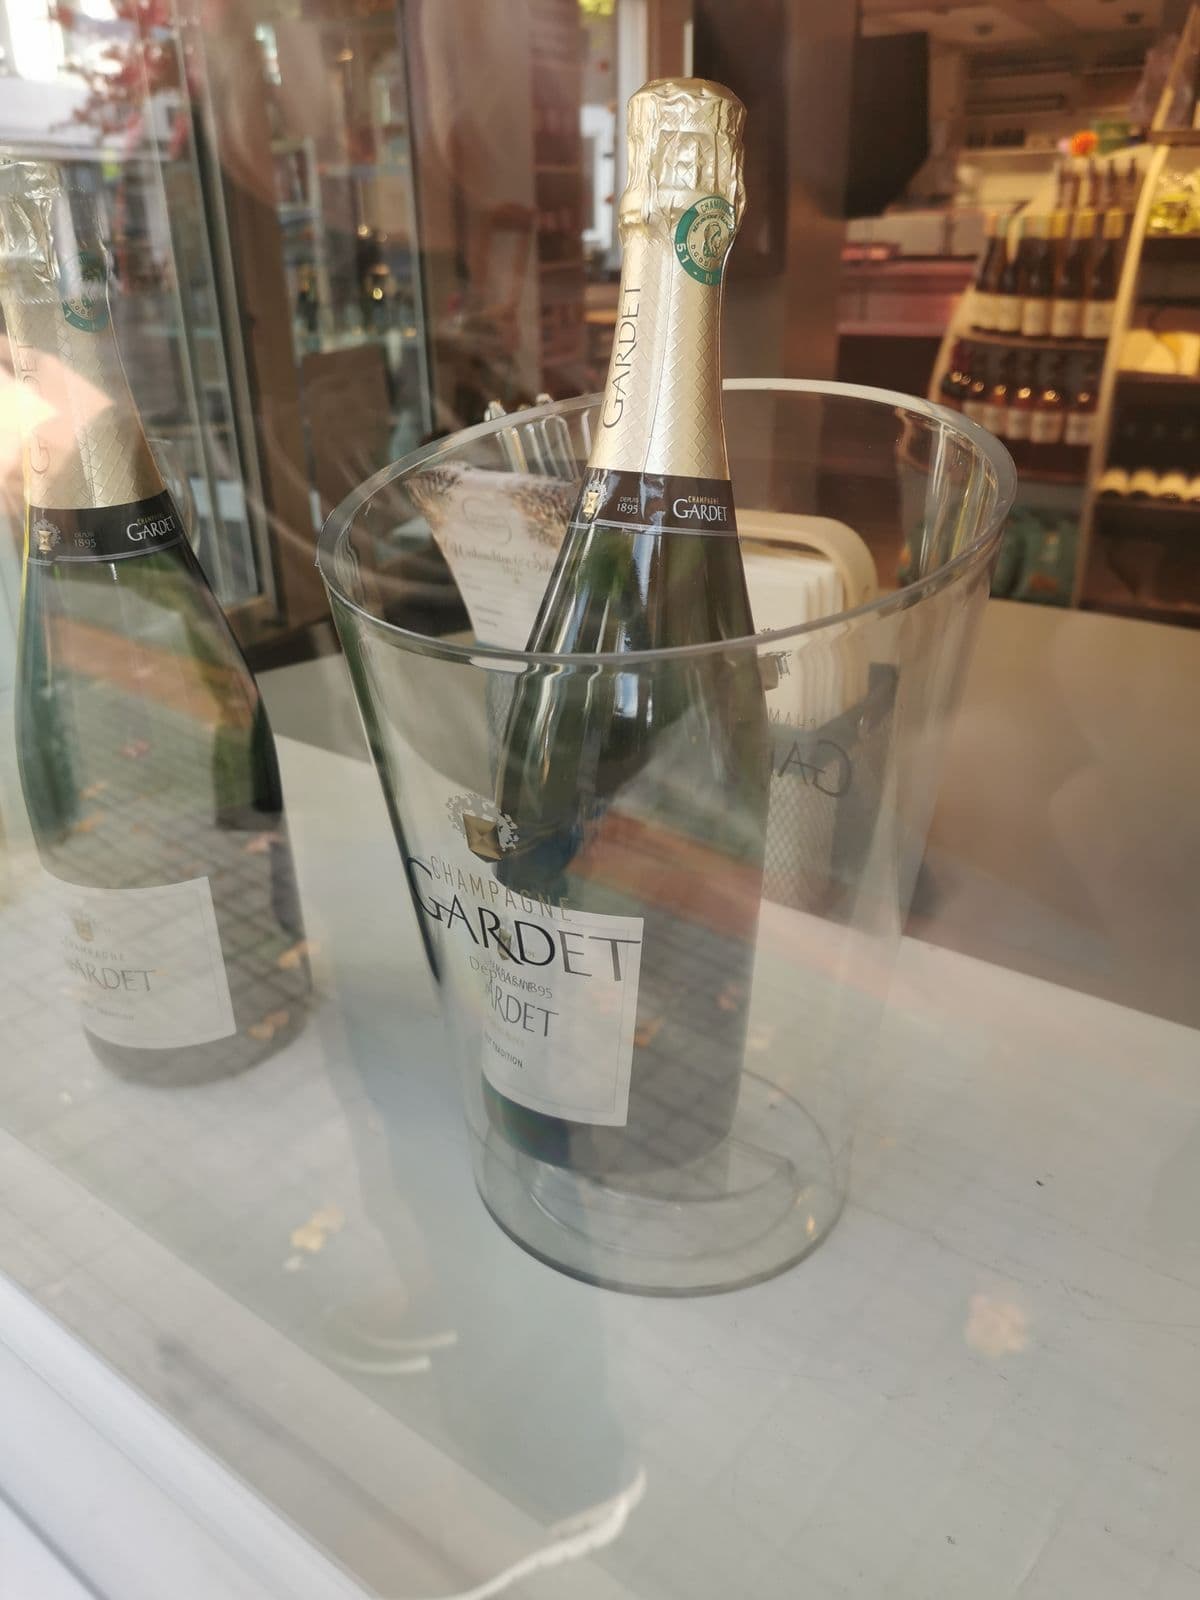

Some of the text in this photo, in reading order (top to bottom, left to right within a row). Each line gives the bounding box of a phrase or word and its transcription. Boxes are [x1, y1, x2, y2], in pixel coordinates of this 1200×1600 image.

[602, 280, 642, 429] GARDET
[616, 502, 639, 515] 1895
[672, 498, 728, 522] GARDET
[126, 515, 176, 542] GARDET
[74, 538, 97, 549] 1895
[429, 855, 573, 923] CHAMPAGNE
[406, 856, 642, 983] GARDET
